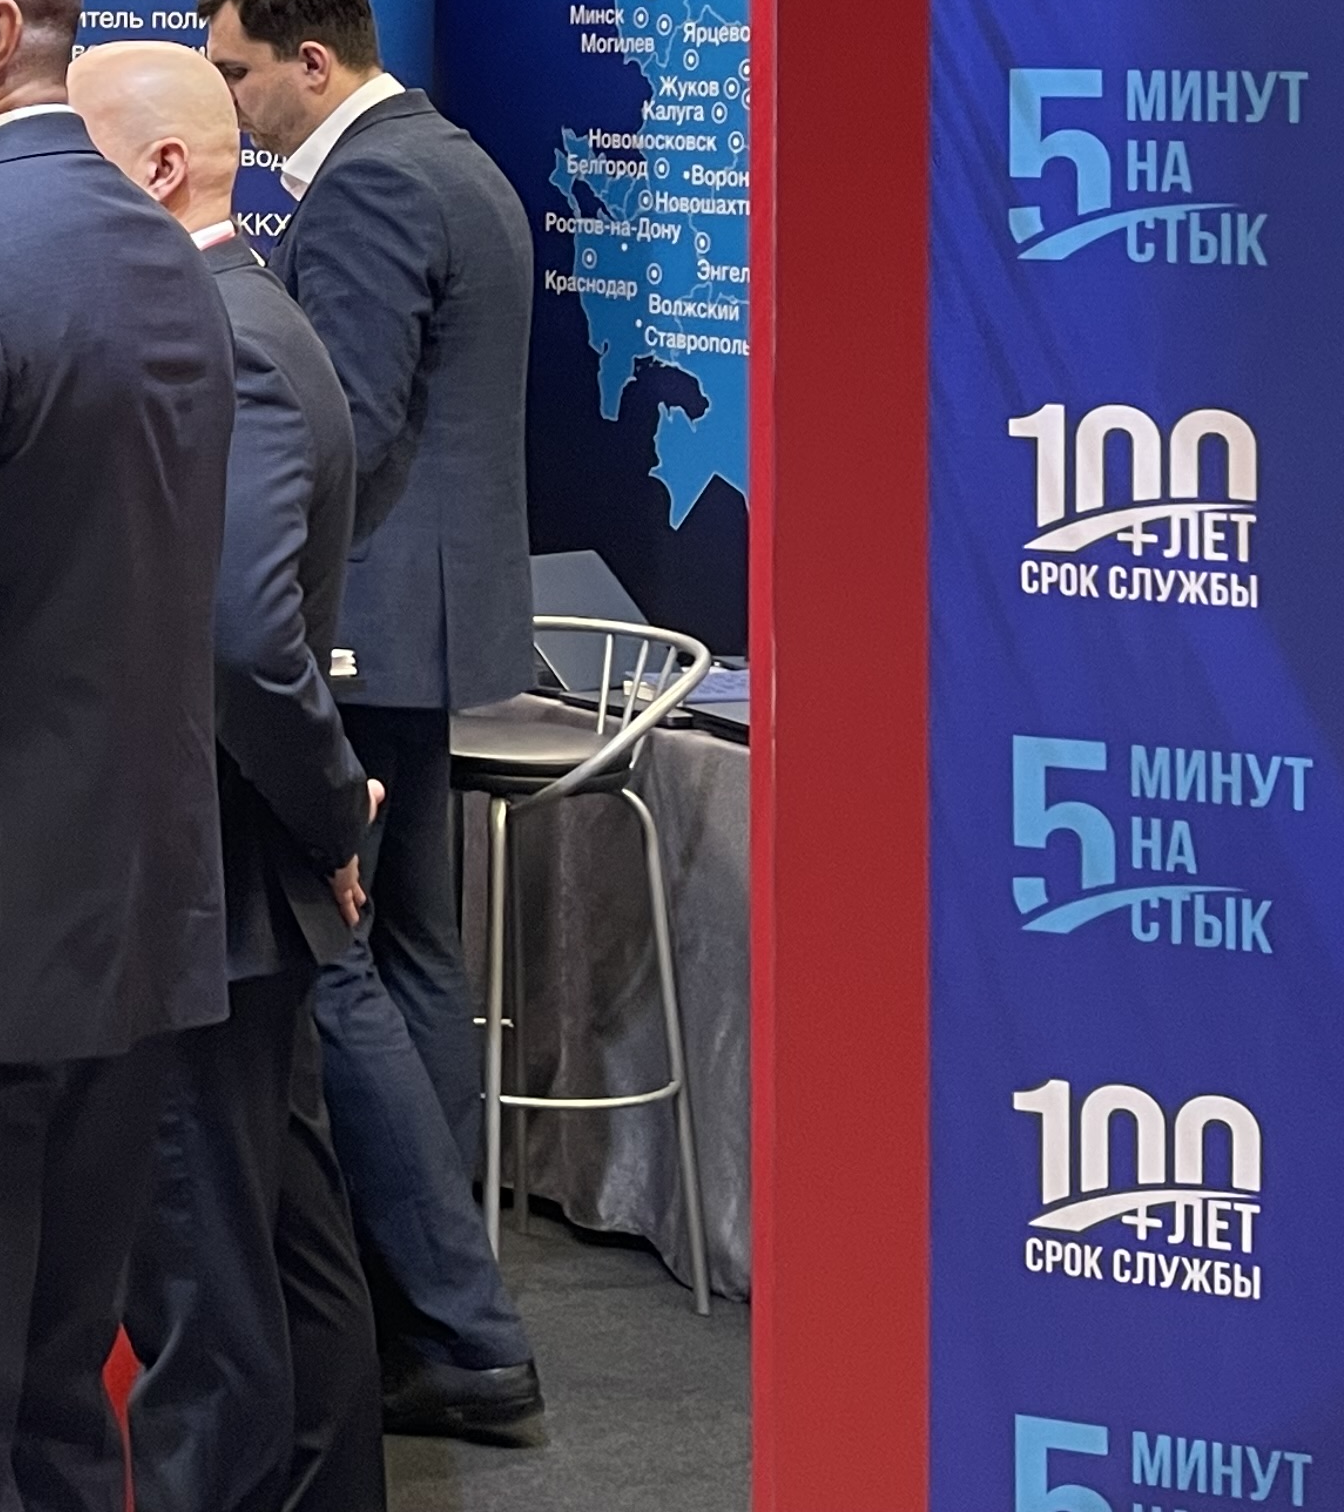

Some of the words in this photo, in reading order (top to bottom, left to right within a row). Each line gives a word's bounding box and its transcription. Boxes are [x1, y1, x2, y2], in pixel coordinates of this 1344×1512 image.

[569, 4, 625, 25] Минск
[683, 22, 750, 47] Ярцево
[581, 33, 655, 53] Могилев
[642, 100, 705, 125] Калуга
[659, 76, 719, 101] Жуков
[588, 128, 717, 151] Новомосковск
[1009, 68, 1111, 245] 5
[1126, 69, 1309, 124] МИНУТ
[566, 154, 648, 181] Белгород
[1127, 139, 1192, 194] НА
[545, 212, 681, 244] Ростов-на-Дону
[1127, 210, 1268, 266] СТЫК
[545, 269, 637, 301] Краснодар
[648, 293, 740, 322] Волжский
[1009, 403, 1257, 528] 100
[1020, 559, 1100, 599] СРОК
[1108, 565, 1258, 608] СЛУЖБЫ
[1012, 734, 1116, 915] 5
[1130, 744, 1314, 812] МИНУТ
[1131, 816, 1197, 875] НА
[1131, 894, 1273, 954] СТЫК
[1013, 1079, 1261, 1205] 100
[1025, 1237, 1103, 1280] СРОК
[1112, 1248, 1261, 1300] СЛУЖБЫ
[1132, 1431, 1312, 1507] МИНУТ
